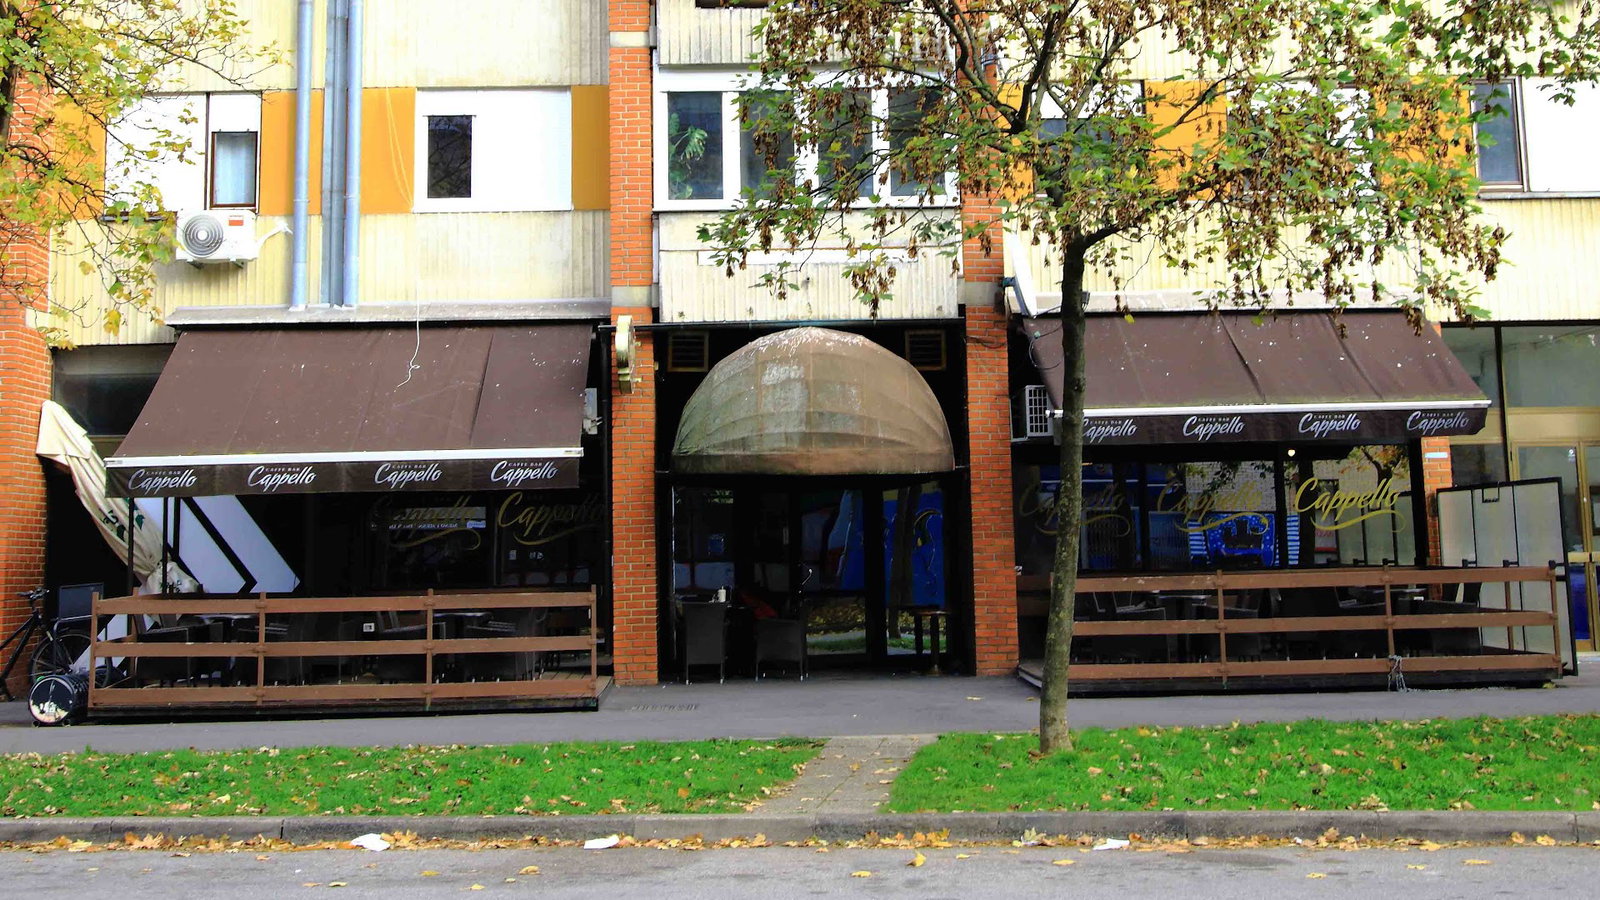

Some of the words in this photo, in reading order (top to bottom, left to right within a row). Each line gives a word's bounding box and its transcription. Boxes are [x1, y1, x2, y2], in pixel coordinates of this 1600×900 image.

[1183, 415, 1245, 441] Cappello
[1298, 412, 1361, 438] Cappello
[1406, 411, 1469, 436] Cappello
[128, 468, 198, 495] Cappello
[247, 465, 317, 492] Cappello
[374, 462, 443, 489] Cappello
[490, 460, 559, 487] Cappello
[1294, 477, 1401, 522] Cappello
